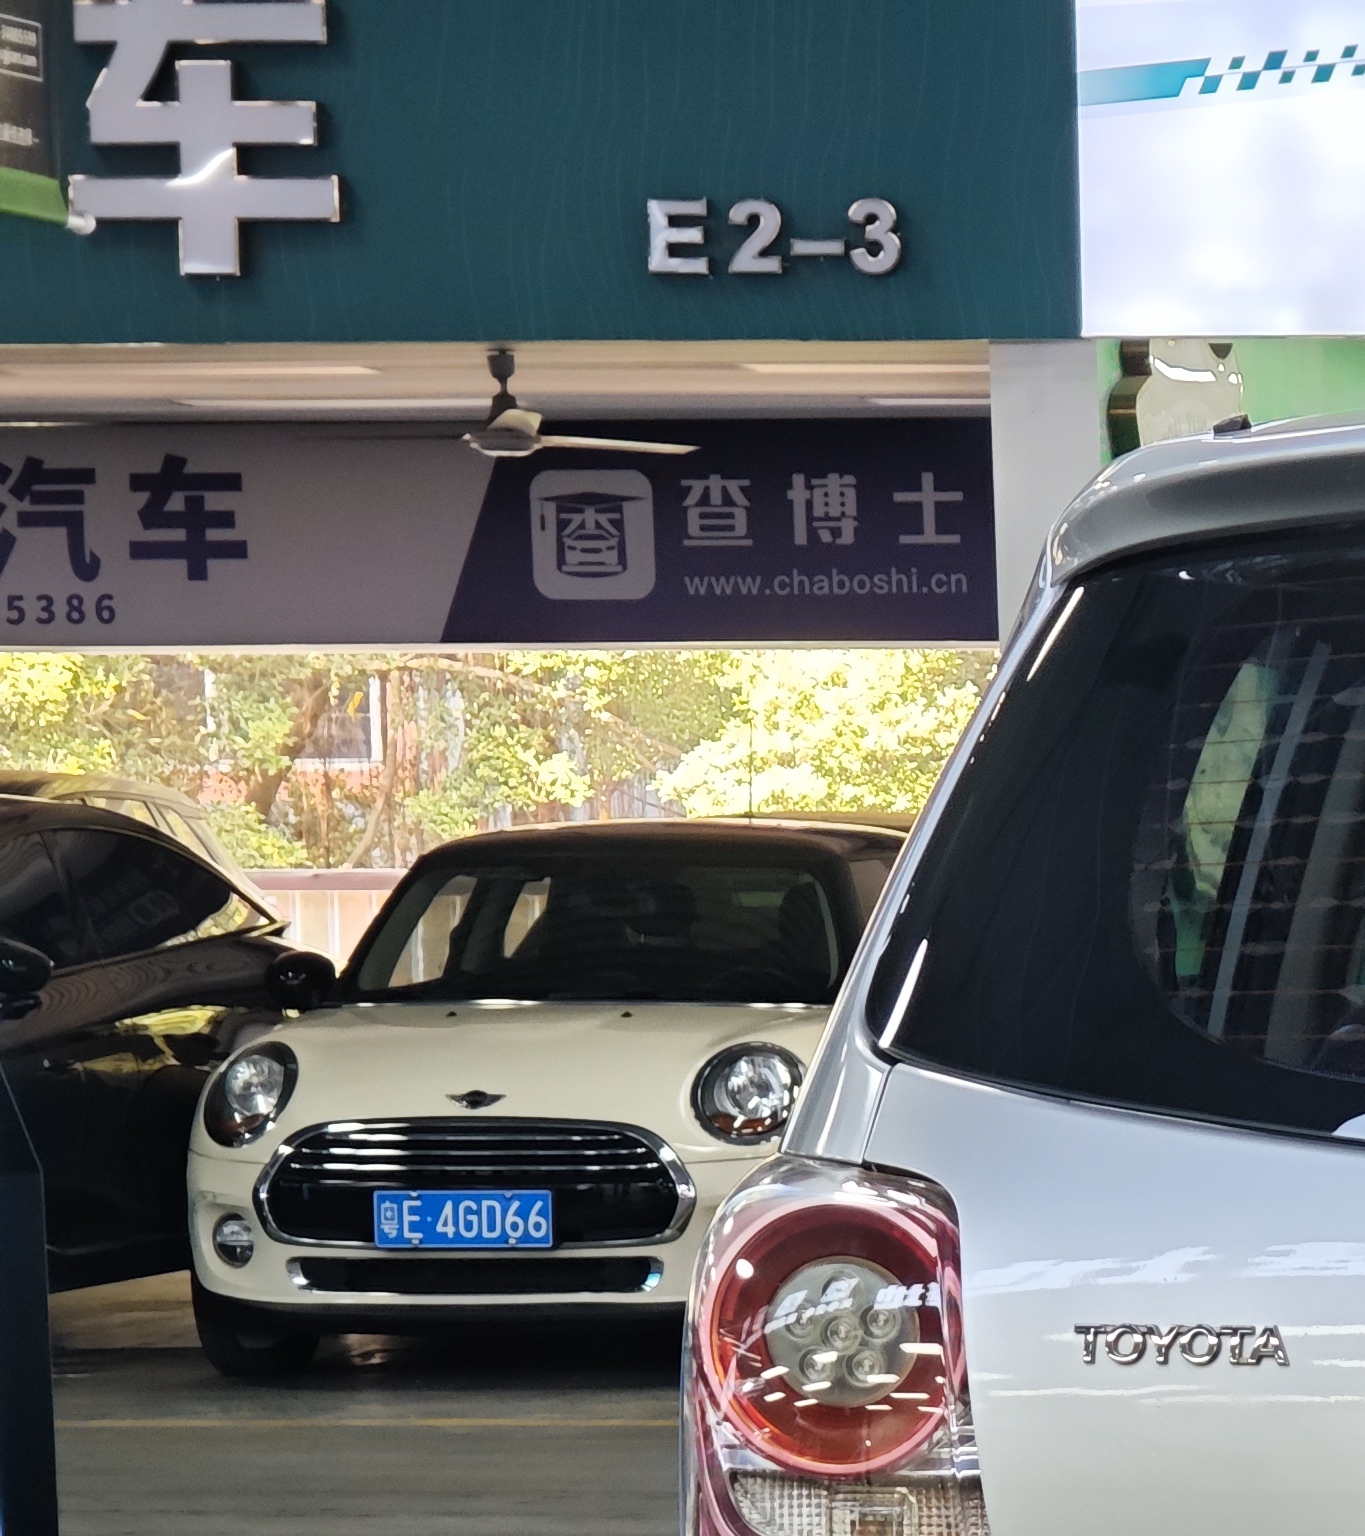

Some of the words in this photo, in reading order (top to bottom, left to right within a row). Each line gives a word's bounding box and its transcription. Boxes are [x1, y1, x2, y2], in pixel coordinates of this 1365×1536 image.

[66, 0, 341, 277] 车
[646, 198, 902, 276] E2-3
[0, 453, 248, 582] 汽车
[680, 472, 964, 546] 查博士
[6, 593, 116, 625] 5386
[684, 568, 968, 596] www.chaboshi.cn
[1075, 1323, 1290, 1366] TOYOTA
